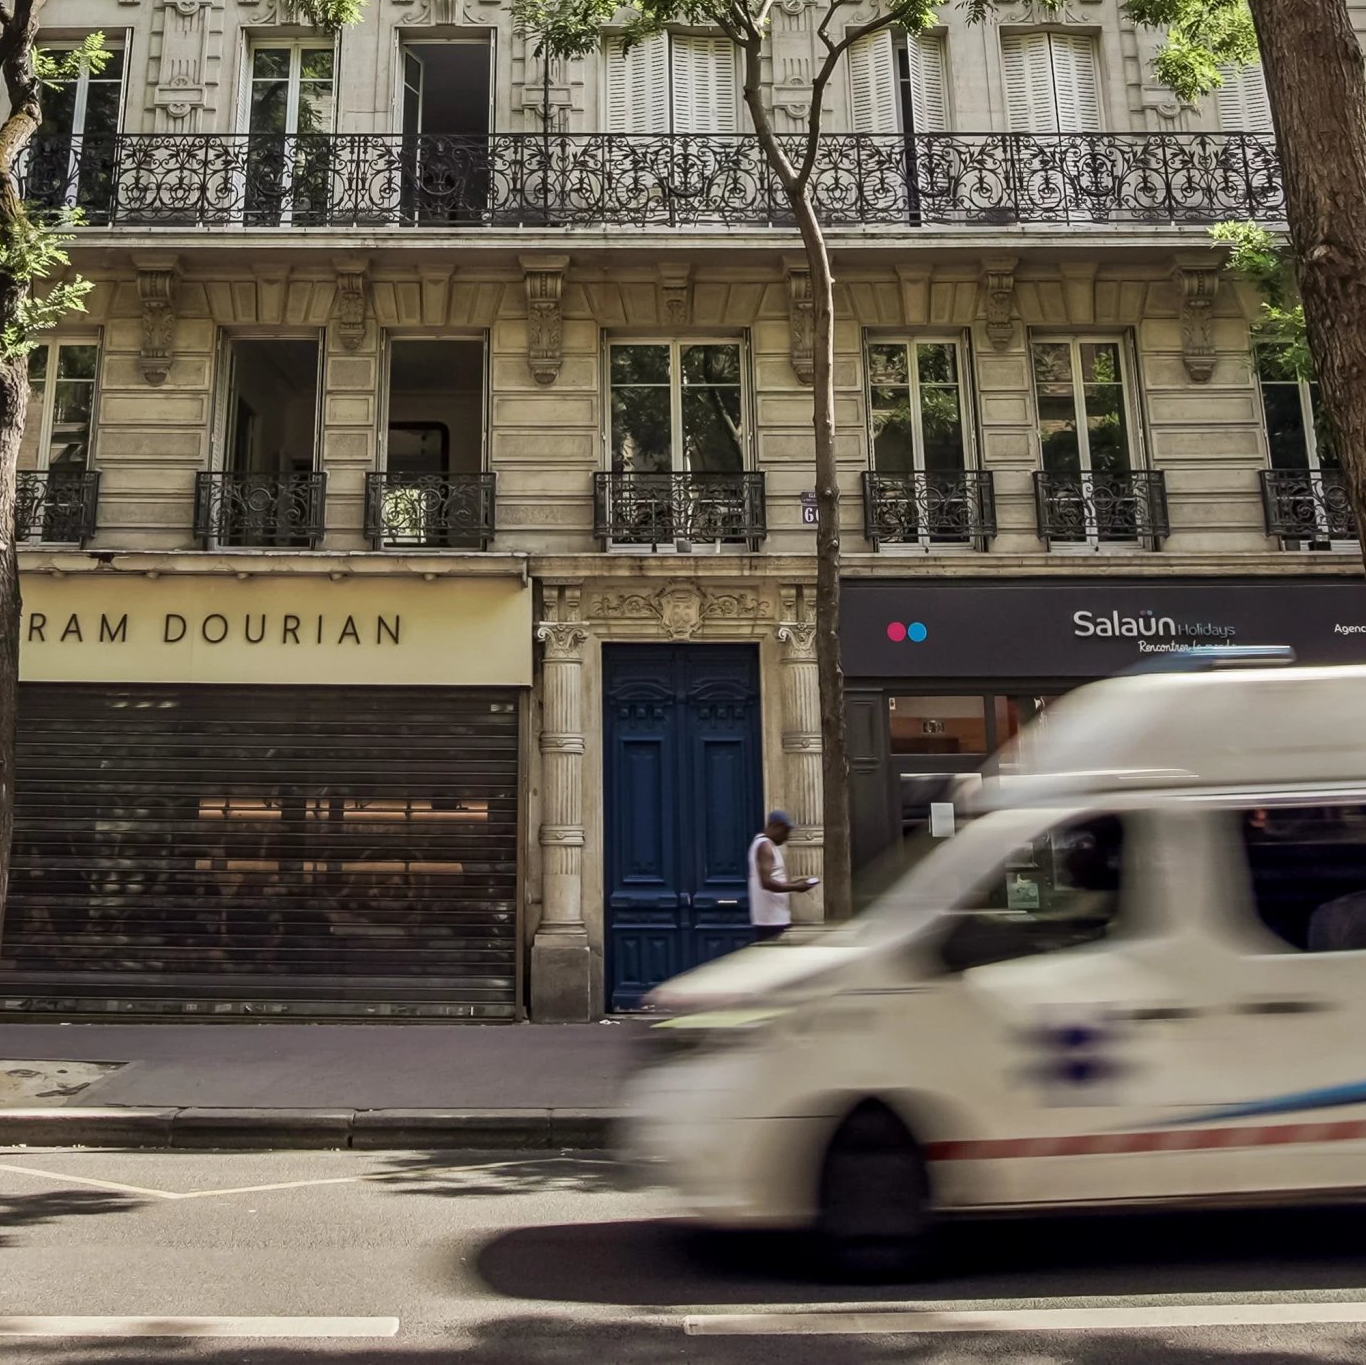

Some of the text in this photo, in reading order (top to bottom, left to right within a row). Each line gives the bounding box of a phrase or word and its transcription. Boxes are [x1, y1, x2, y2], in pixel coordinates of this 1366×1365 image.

[28, 613, 400, 645] RAM DOURIAN
[1073, 610, 1235, 638] Salaün Holidays
